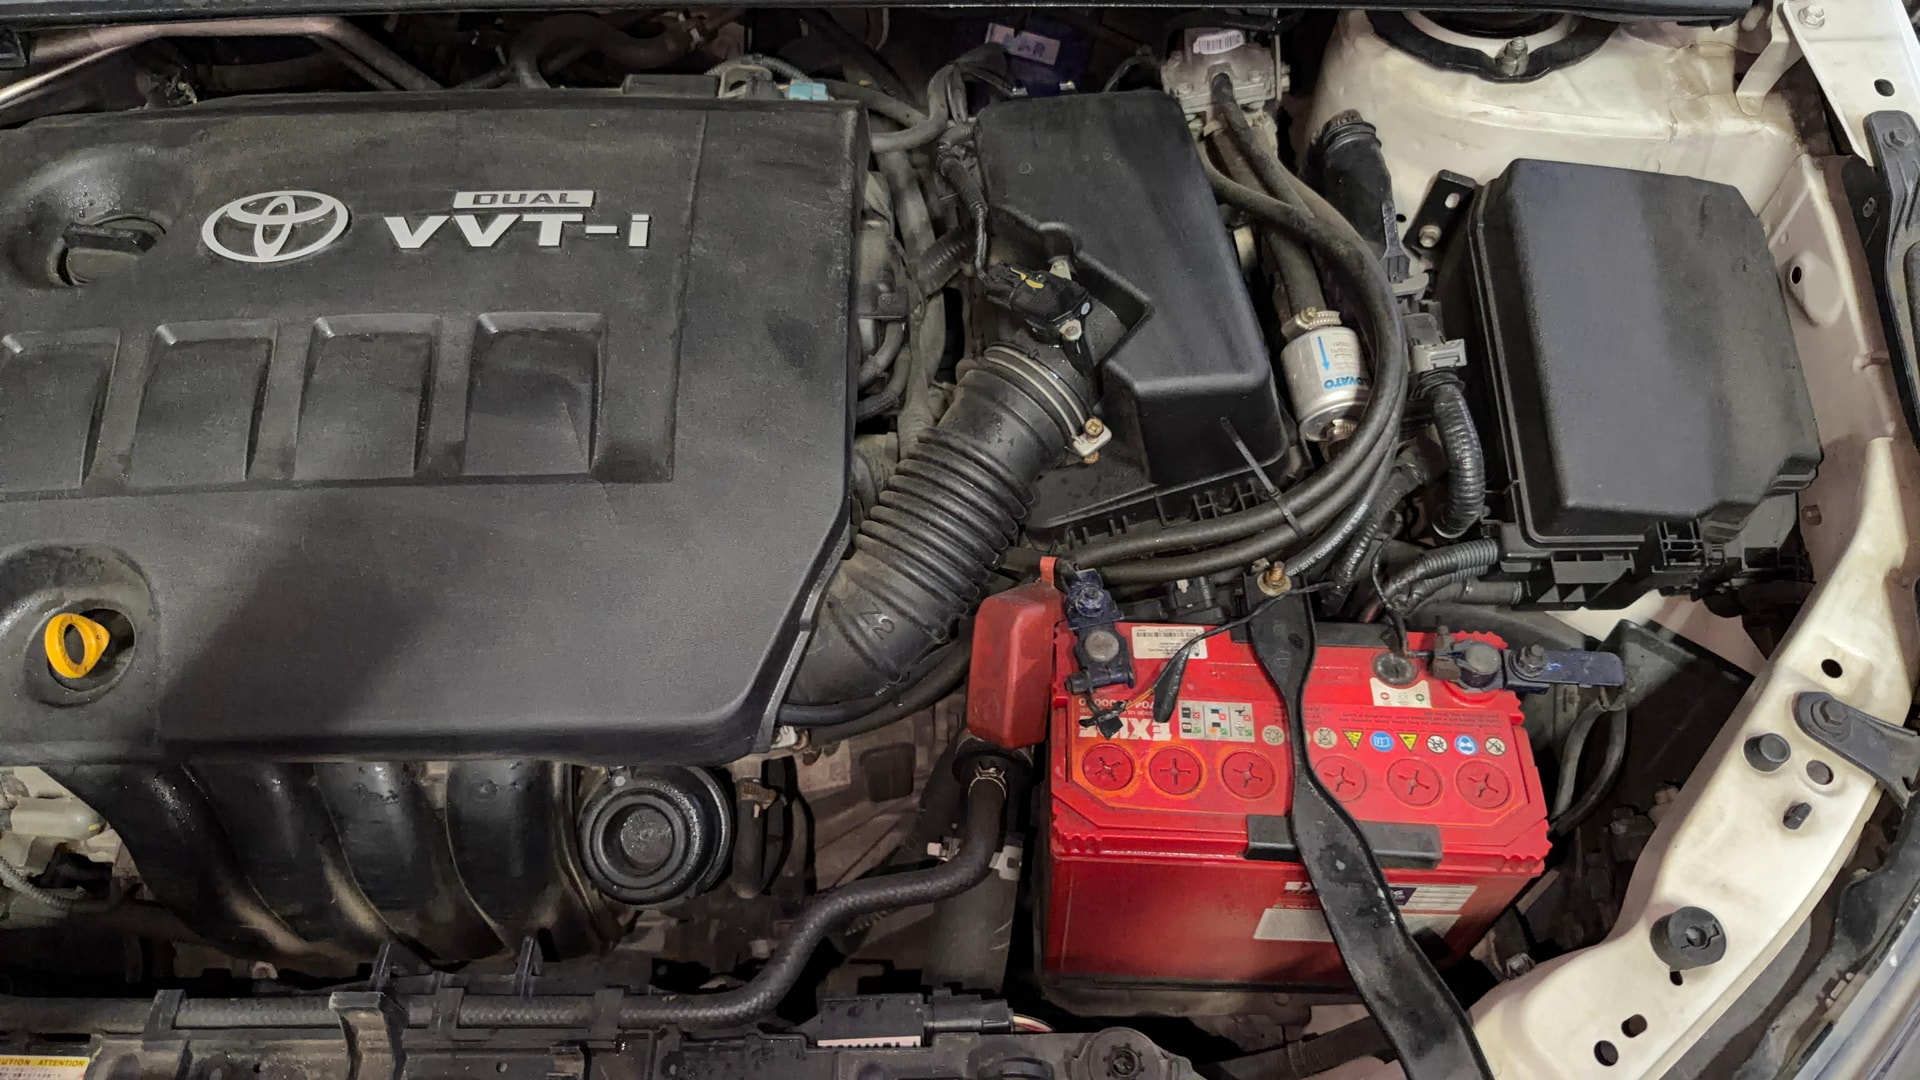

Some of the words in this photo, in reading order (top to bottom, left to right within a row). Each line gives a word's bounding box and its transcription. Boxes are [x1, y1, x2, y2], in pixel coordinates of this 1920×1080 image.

[472, 192, 580, 206] DUAL
[383, 213, 650, 249] VVT-i
[1323, 375, 1367, 390] OVATO
[0, 1058, 31, 1066] UTION
[38, 1059, 85, 1067] ATTENTION
